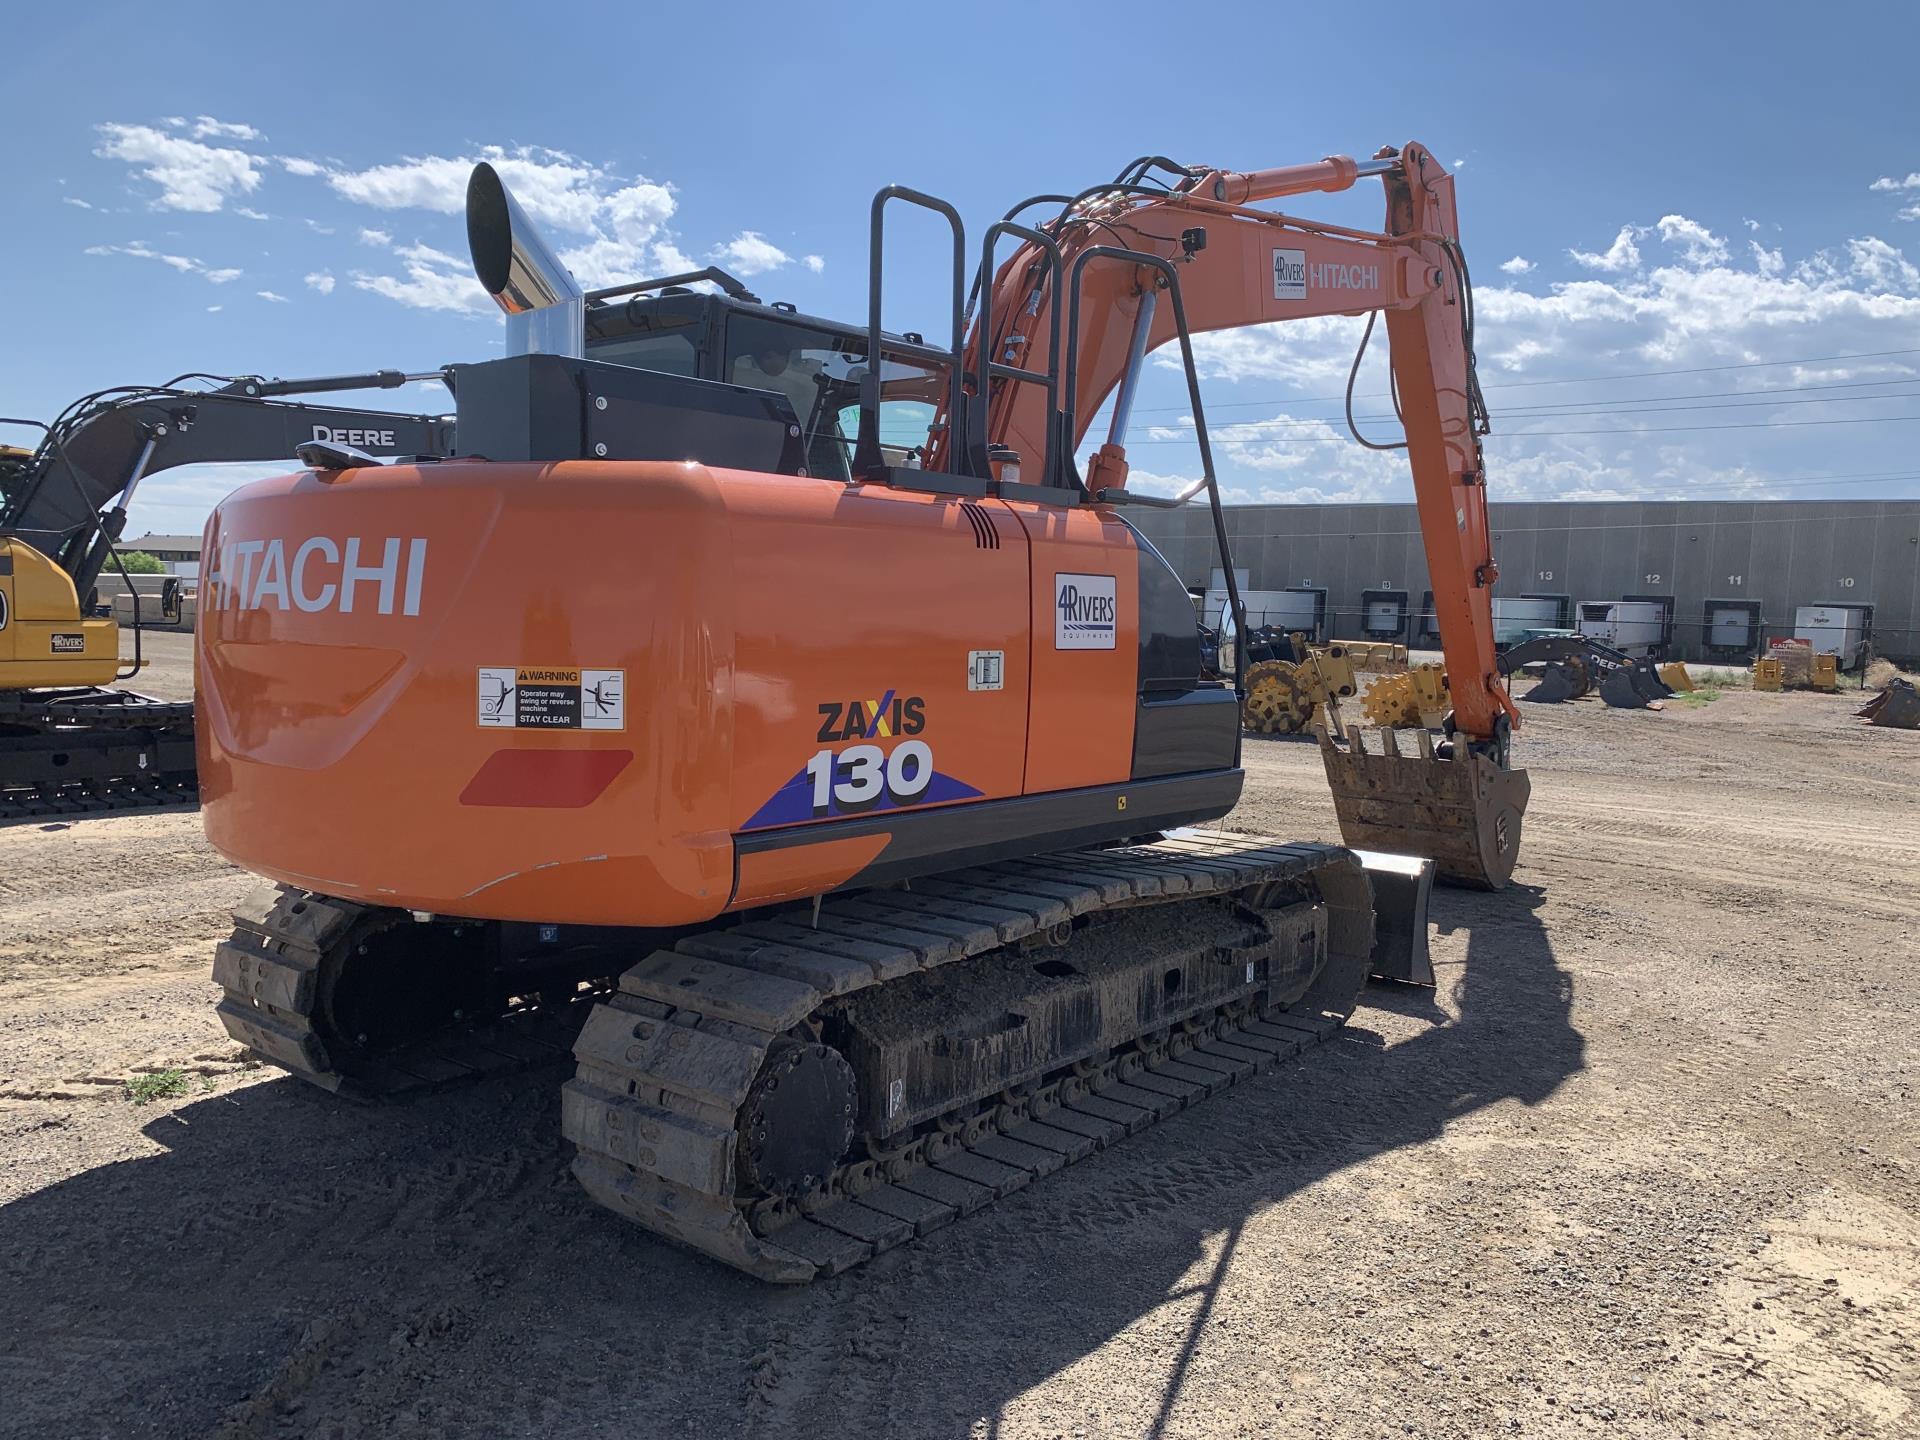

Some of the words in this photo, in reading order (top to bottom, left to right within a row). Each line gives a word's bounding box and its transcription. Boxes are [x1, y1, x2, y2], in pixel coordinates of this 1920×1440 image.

[1310, 263, 1379, 289] HITACHI
[312, 425, 395, 446] DEERE
[205, 536, 427, 616] HITACHI
[1538, 571, 1553, 581] 13
[1645, 574, 1661, 584] 12
[1727, 575, 1742, 585] 11
[1838, 577, 1855, 587] 10
[1058, 584, 1114, 622] 4RIVERS
[1591, 654, 1624, 671] DEE
[529, 671, 578, 682] WARNING
[520, 690, 549, 699] Operator
[550, 691, 565, 699] may
[520, 698, 539, 706] swing
[520, 715, 540, 723] STAY
[542, 716, 570, 724] CLEAR
[817, 689, 926, 743] ZAXIS
[807, 740, 933, 814] 130
